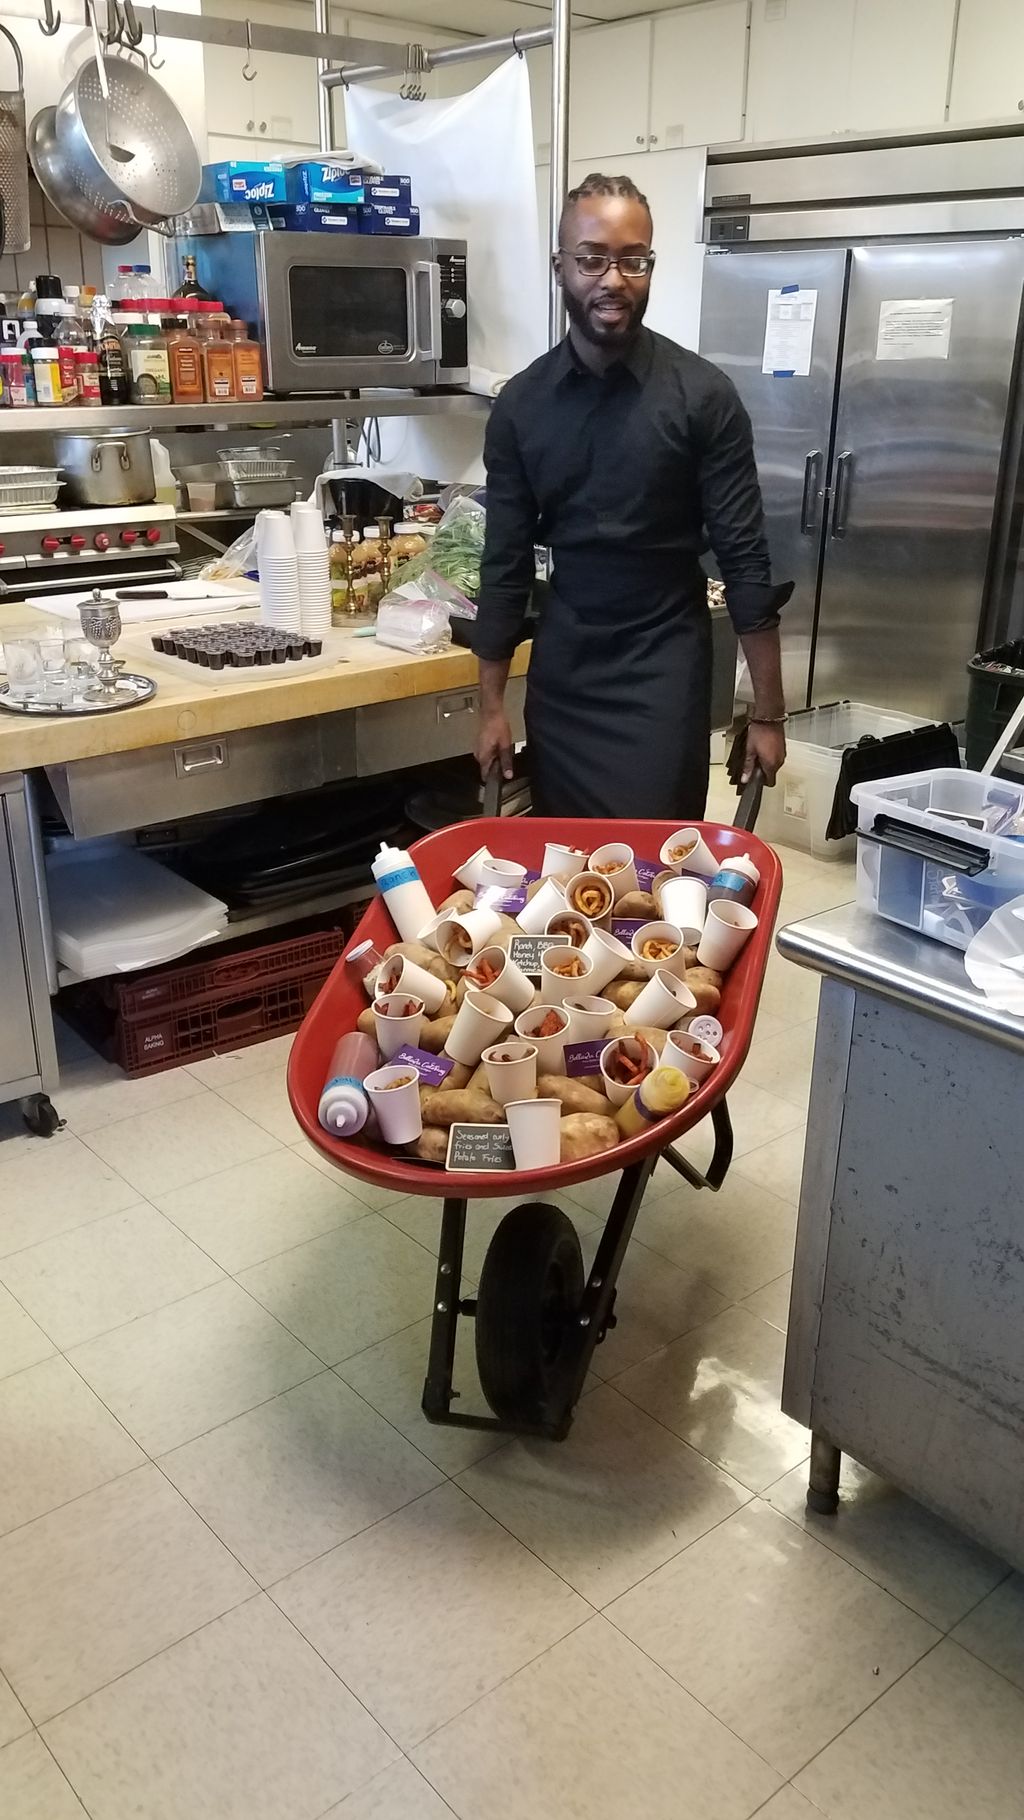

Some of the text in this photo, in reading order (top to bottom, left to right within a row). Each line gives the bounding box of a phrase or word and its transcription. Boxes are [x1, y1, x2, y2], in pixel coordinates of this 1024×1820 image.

[244, 182, 274, 200] Ziploc
[512, 950, 535, 961] Honey
[144, 1033, 163, 1043] ALPHA
[455, 1130, 489, 1140] Seasoned
[475, 1142, 490, 1150] and
[454, 1151, 476, 1162] Potato
